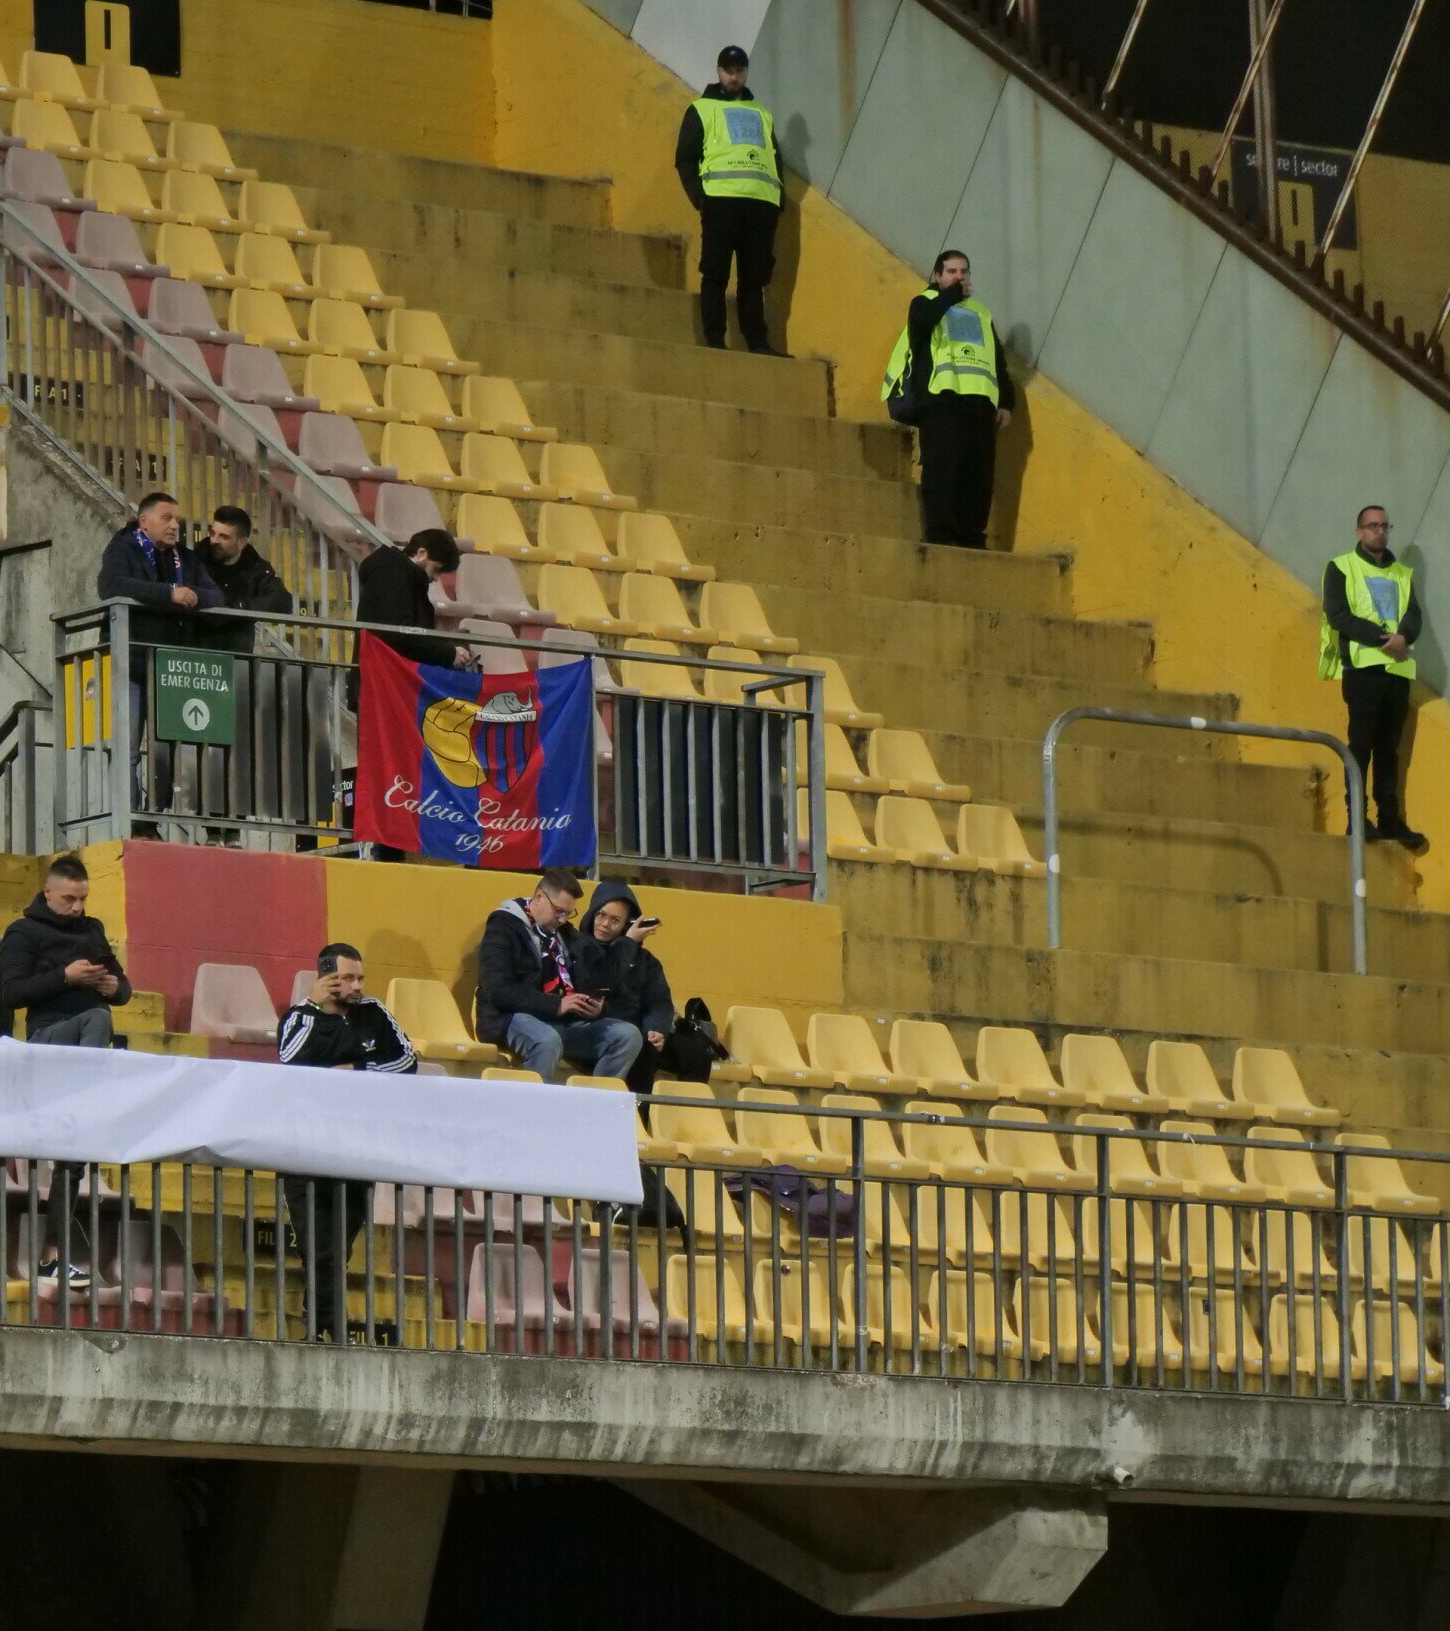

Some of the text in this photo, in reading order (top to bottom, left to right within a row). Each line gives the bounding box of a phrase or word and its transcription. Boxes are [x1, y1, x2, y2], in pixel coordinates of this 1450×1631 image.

[1246, 153, 1291, 171] sere
[1301, 160, 1339, 177] sector
[34, 384, 56, 399] FA
[168, 660, 223, 677] USCITA DI
[161, 674, 229, 692] EMERGENZA
[332, 780, 354, 793] tor
[384, 774, 572, 832] Calcio Catania
[455, 833, 504, 855] 1946
[257, 1231, 297, 1247] FIL 2
